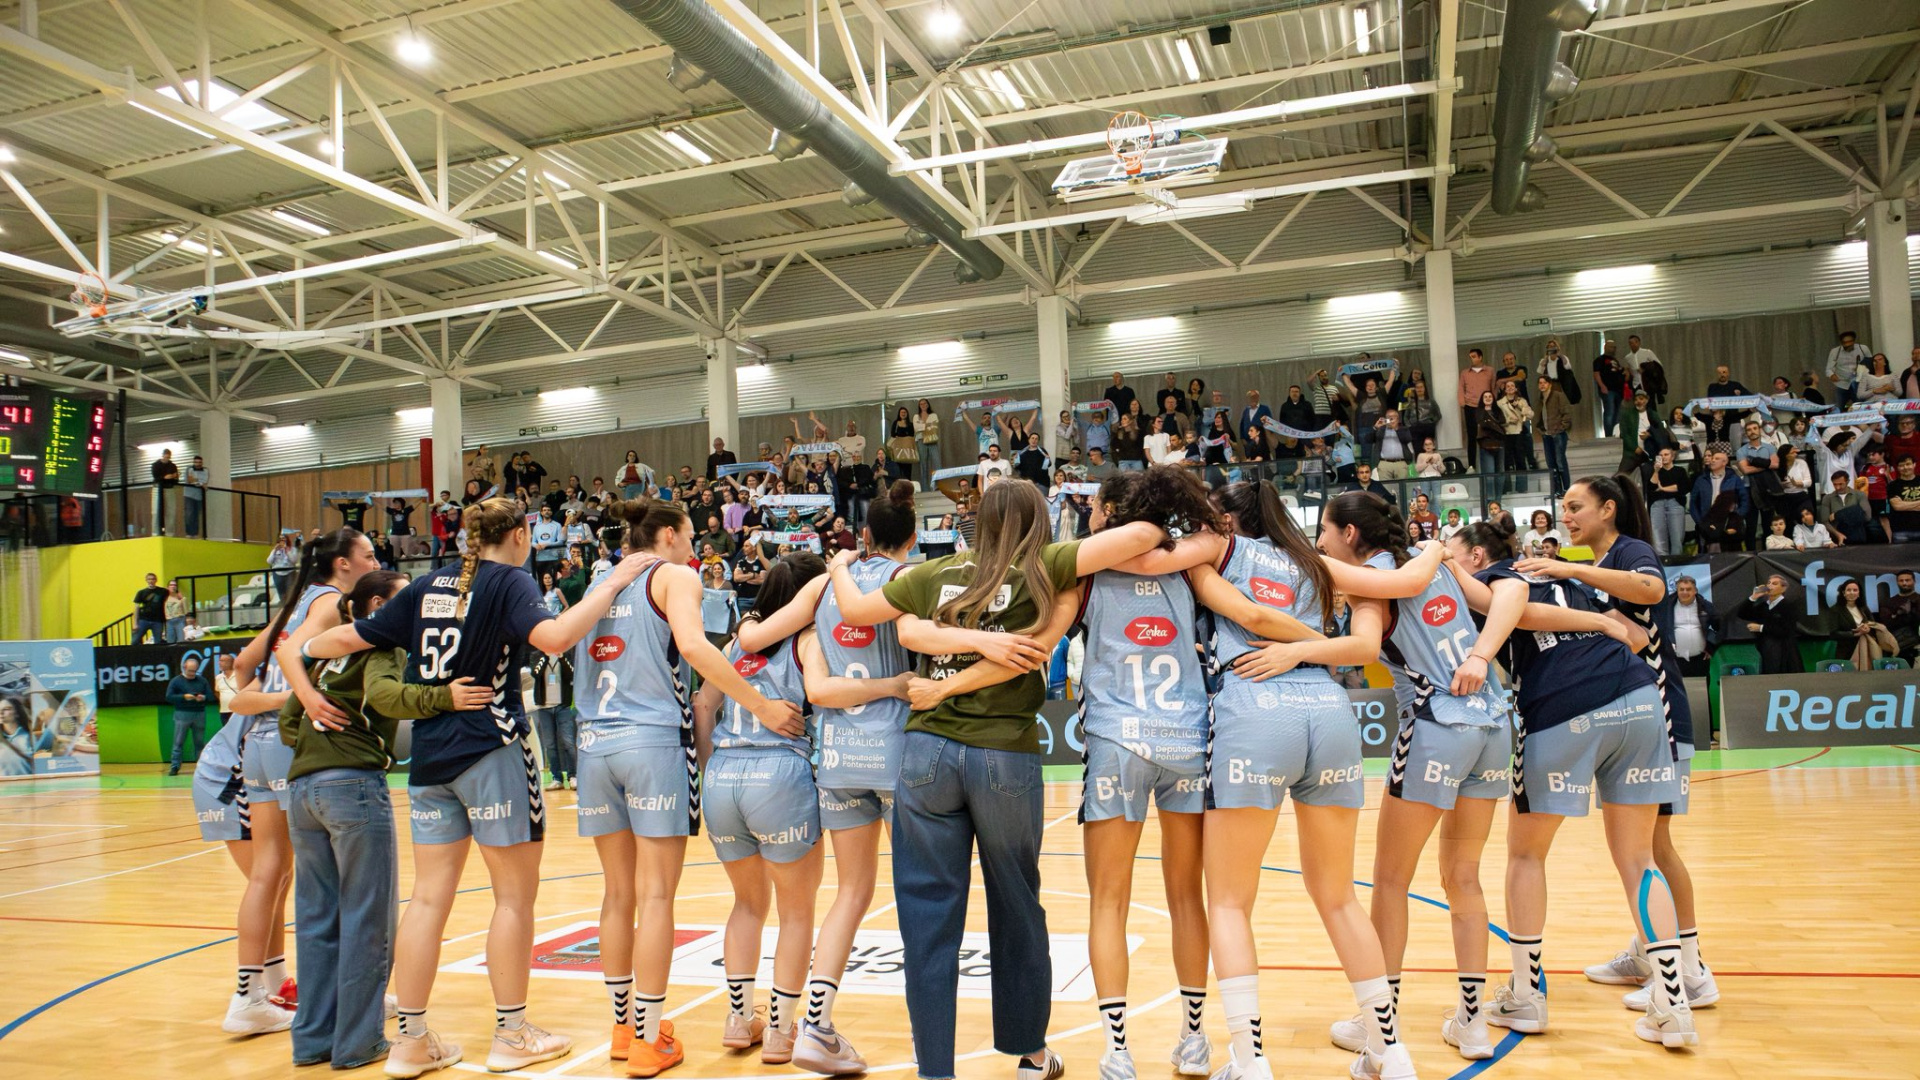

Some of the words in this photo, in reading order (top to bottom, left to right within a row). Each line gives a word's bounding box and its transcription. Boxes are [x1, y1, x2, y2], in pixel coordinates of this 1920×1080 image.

[1362, 361, 1388, 371] Celta
[3, 406, 32, 423] 41
[19, 468, 34, 482] 4
[1134, 581, 1163, 596] GEA
[1255, 581, 1286, 600] Zorka
[841, 626, 868, 641] Zorka
[1135, 622, 1169, 640] Zorka
[420, 627, 461, 681] 52
[1124, 654, 1186, 711] 12
[597, 669, 621, 718] 2
[1593, 710, 1622, 720] SAVINO
[1766, 685, 1920, 733] Recal
[836, 726, 864, 737] XUNTA
[1143, 729, 1157, 738] DE
[1160, 729, 1202, 739] GALICIA
[834, 736, 846, 745] DE
[848, 737, 885, 747] GALICIA
[1625, 767, 1676, 785] Recal
[627, 792, 677, 811] Recalvi
[826, 798, 861, 811] travel
[466, 800, 512, 821] ecalvi
